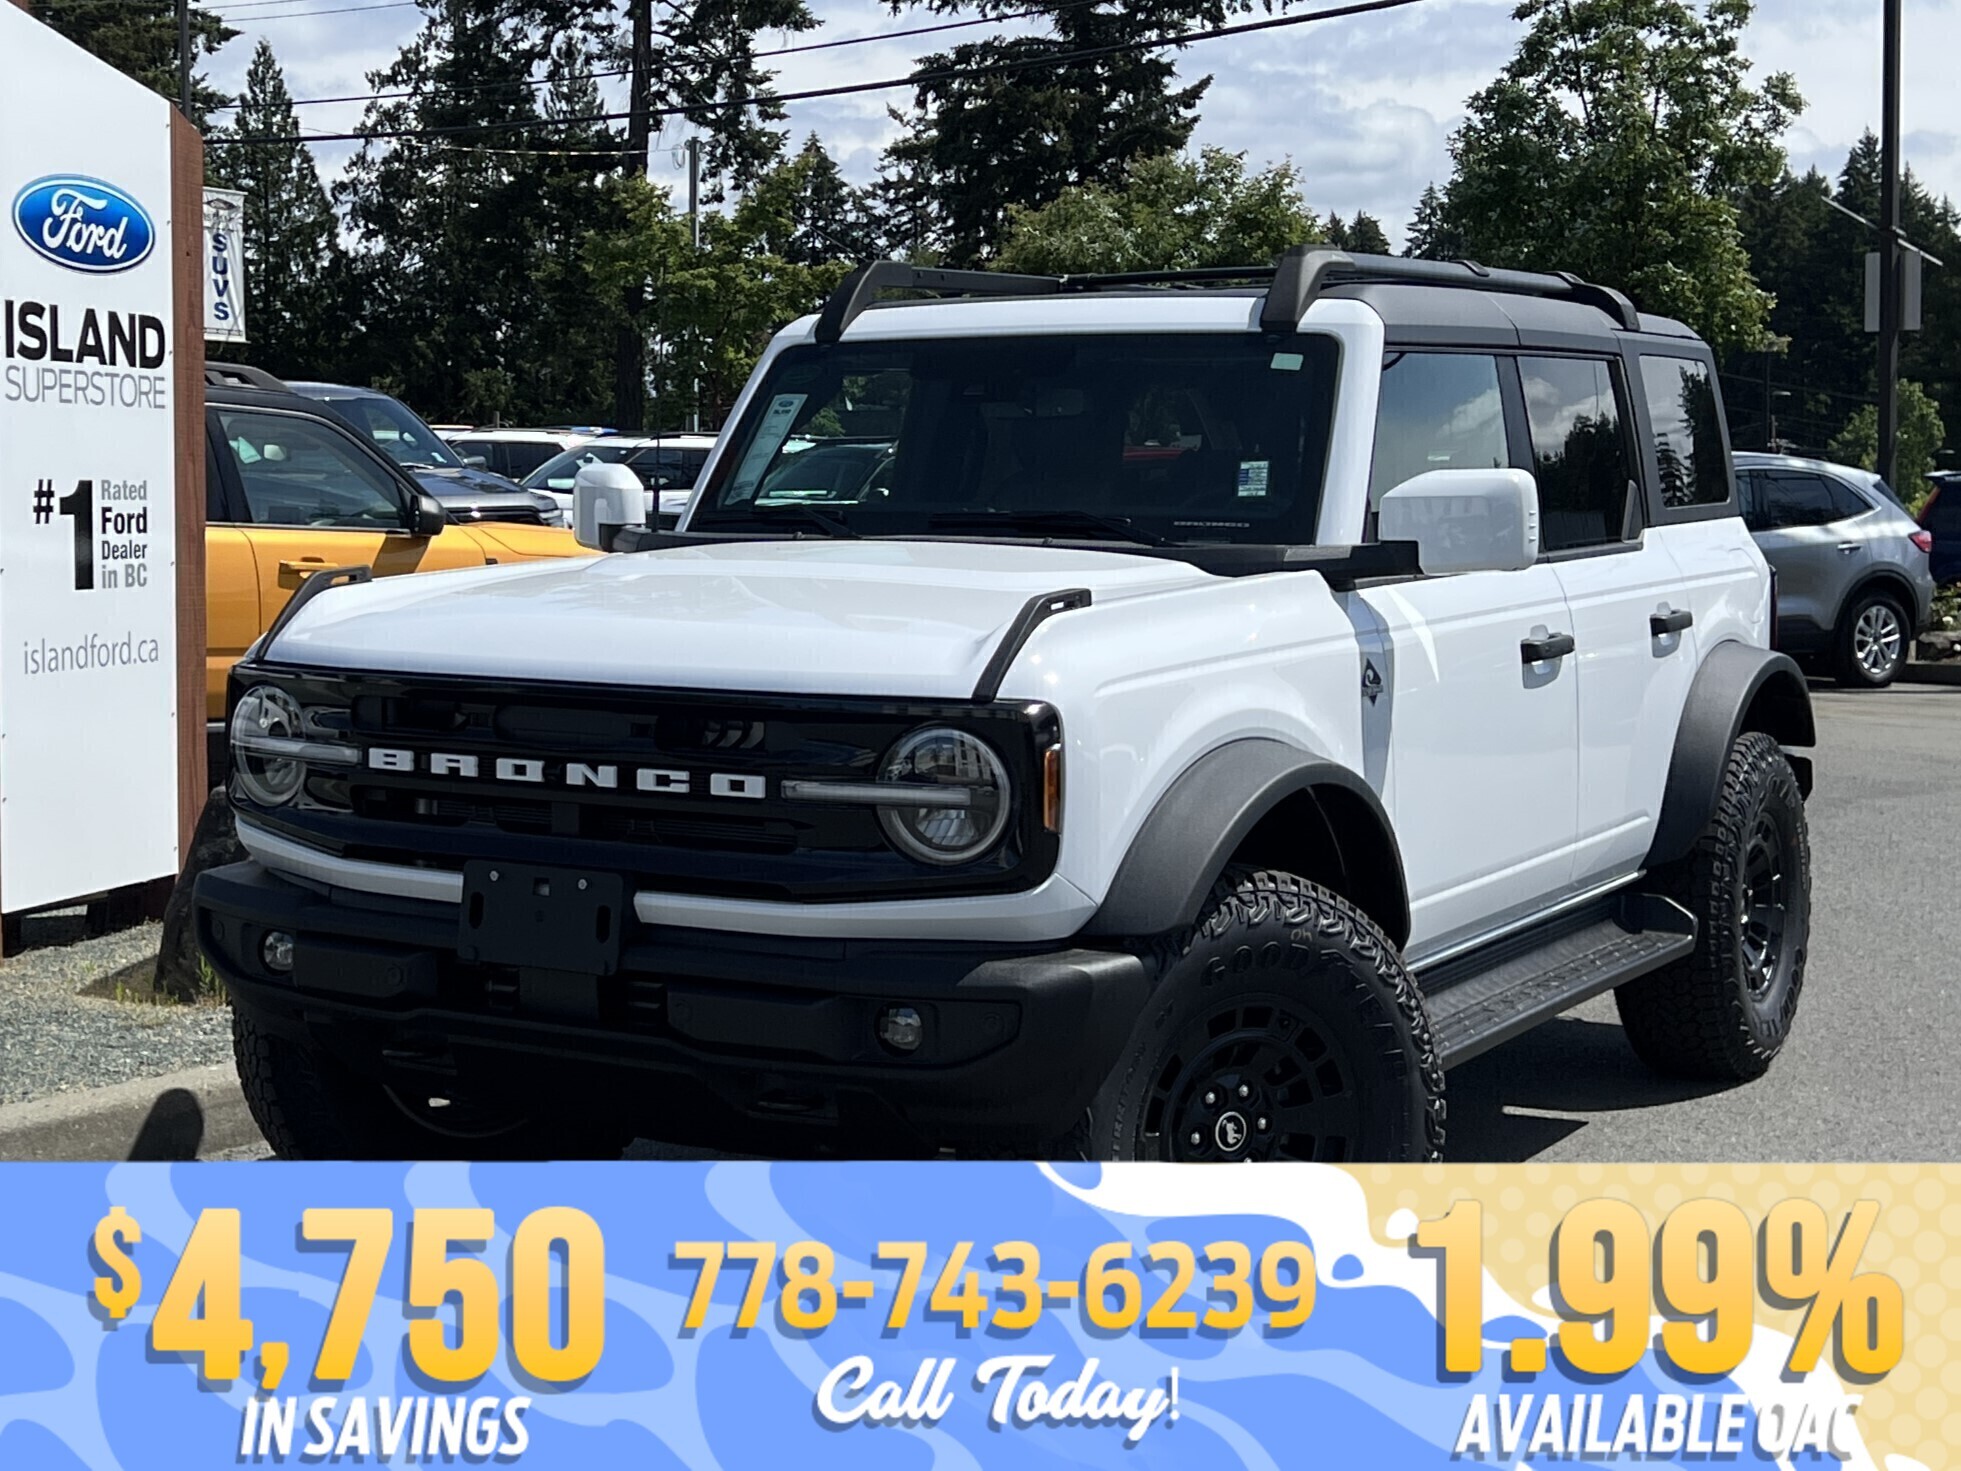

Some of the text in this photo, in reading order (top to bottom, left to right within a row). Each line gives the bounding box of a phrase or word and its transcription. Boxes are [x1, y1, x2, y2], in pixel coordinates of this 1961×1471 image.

[42, 188, 129, 259] Ford
[4, 299, 166, 370] ISLAND
[4, 365, 166, 409] SUPERSTORE
[101, 479, 148, 501] Rated
[33, 479, 95, 591] #1
[101, 506, 148, 534] Ford
[101, 539, 148, 561] Dealer
[101, 562, 148, 589] in BC
[24, 631, 159, 675] islandford.ca
[368, 747, 766, 799] BRONCO
